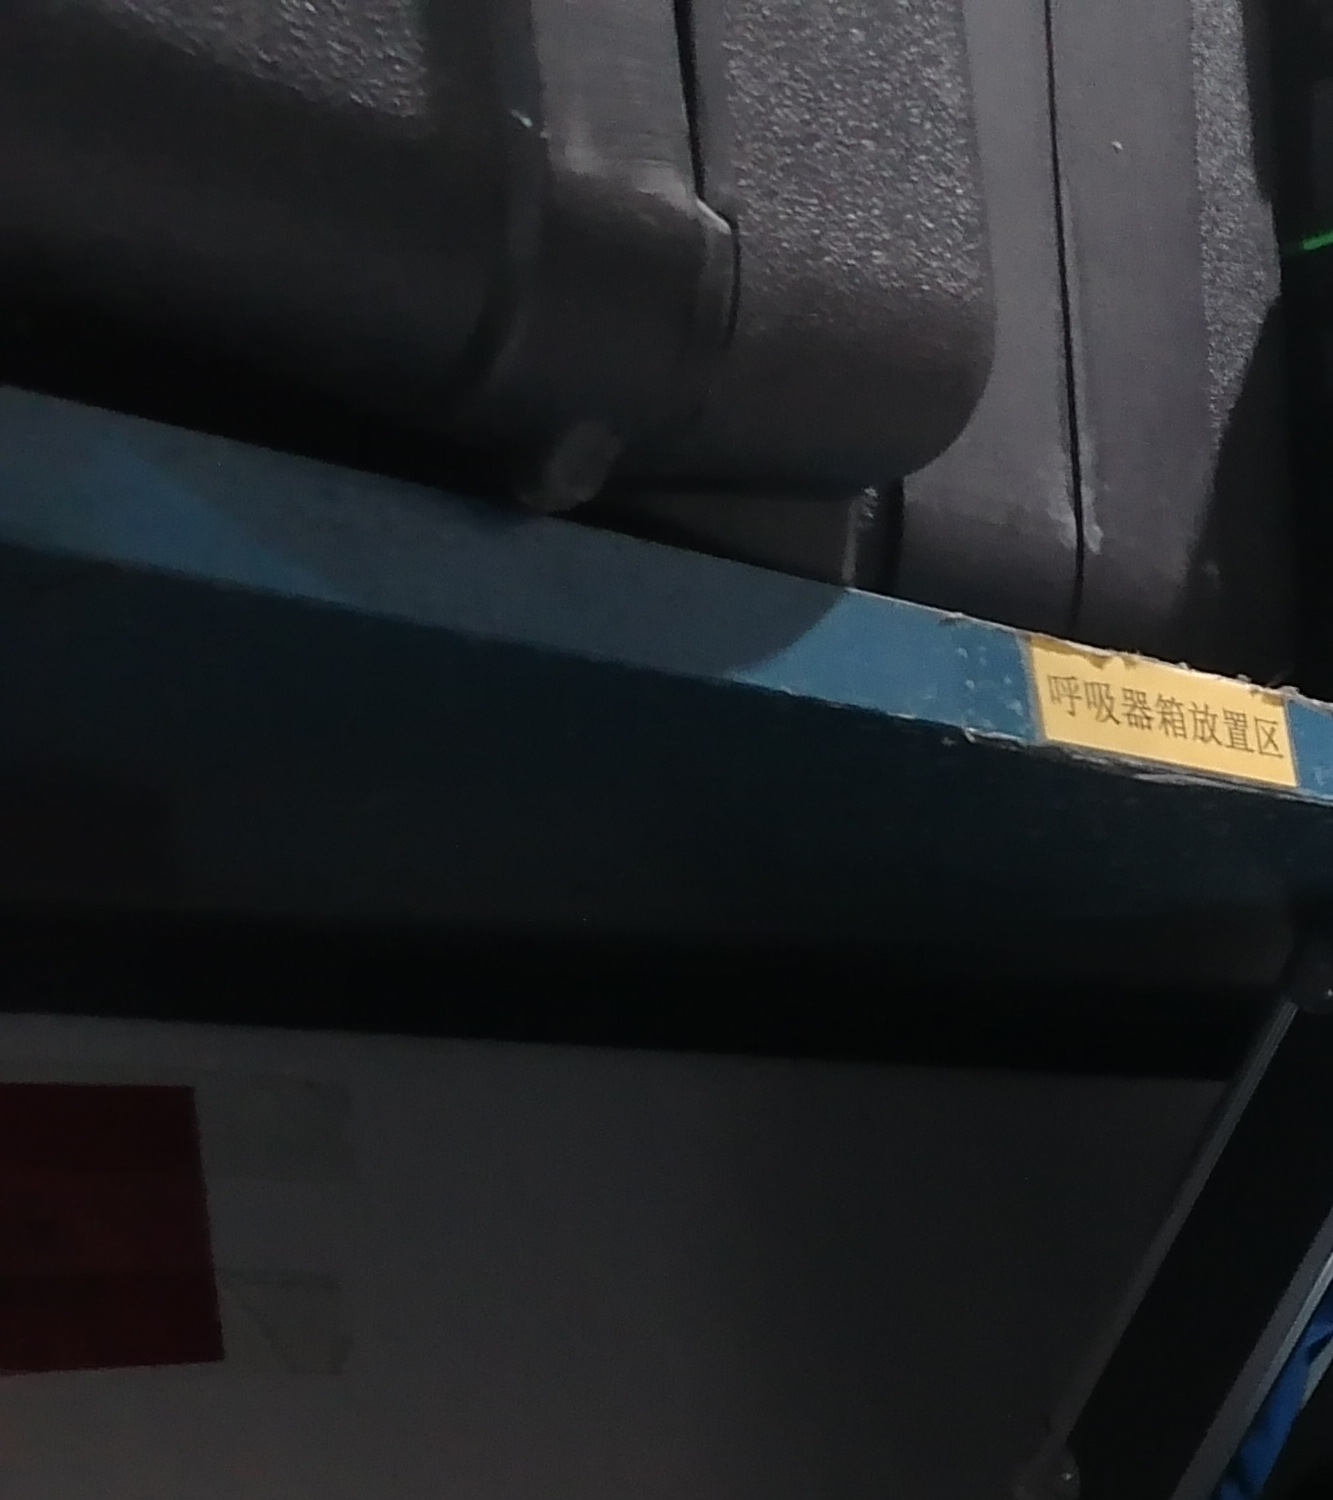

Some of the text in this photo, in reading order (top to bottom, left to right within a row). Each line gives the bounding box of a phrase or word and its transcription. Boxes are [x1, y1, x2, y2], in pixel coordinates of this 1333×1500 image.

[1048, 675, 1284, 759] 呼吸器箱放置区
